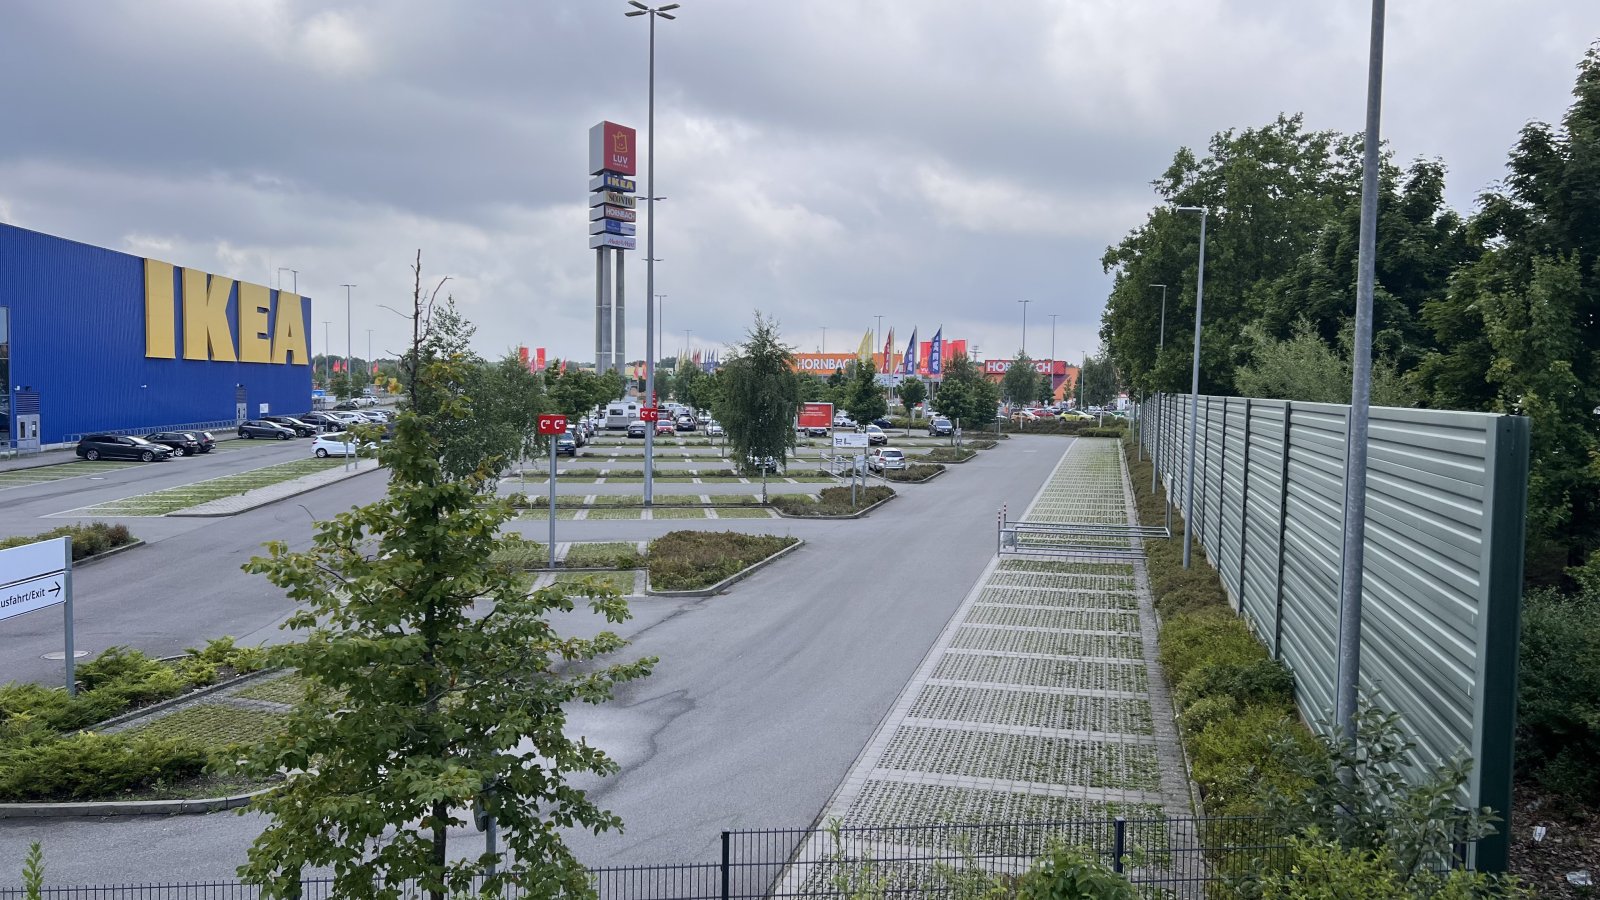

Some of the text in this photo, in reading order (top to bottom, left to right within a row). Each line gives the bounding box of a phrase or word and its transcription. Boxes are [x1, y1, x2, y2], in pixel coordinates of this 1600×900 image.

[613, 154, 628, 164] LUV
[607, 177, 633, 190] IKEA
[608, 194, 633, 206] SCONTO
[606, 208, 635, 219] HORNBACH
[143, 258, 309, 365] IKEA
[0, 588, 45, 608] usfahrt/Exit
